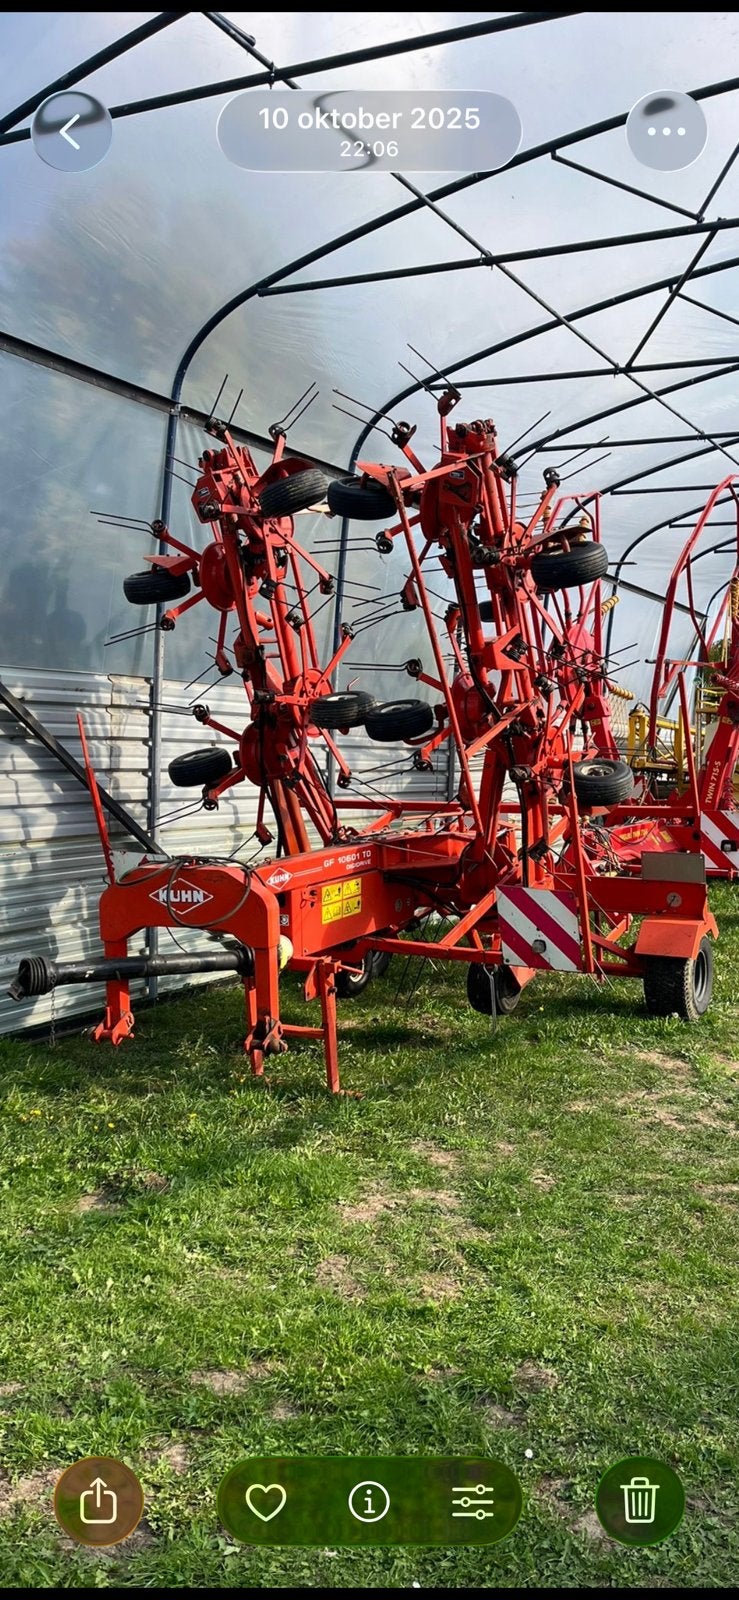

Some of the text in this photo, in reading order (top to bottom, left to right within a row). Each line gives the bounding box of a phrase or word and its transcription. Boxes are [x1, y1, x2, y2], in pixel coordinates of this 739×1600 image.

[705, 782, 716, 803] TWIN
[323, 858, 335, 868] GF
[337, 853, 360, 865] 10601
[269, 873, 290, 884] KUHN
[159, 889, 203, 902] KUHN
